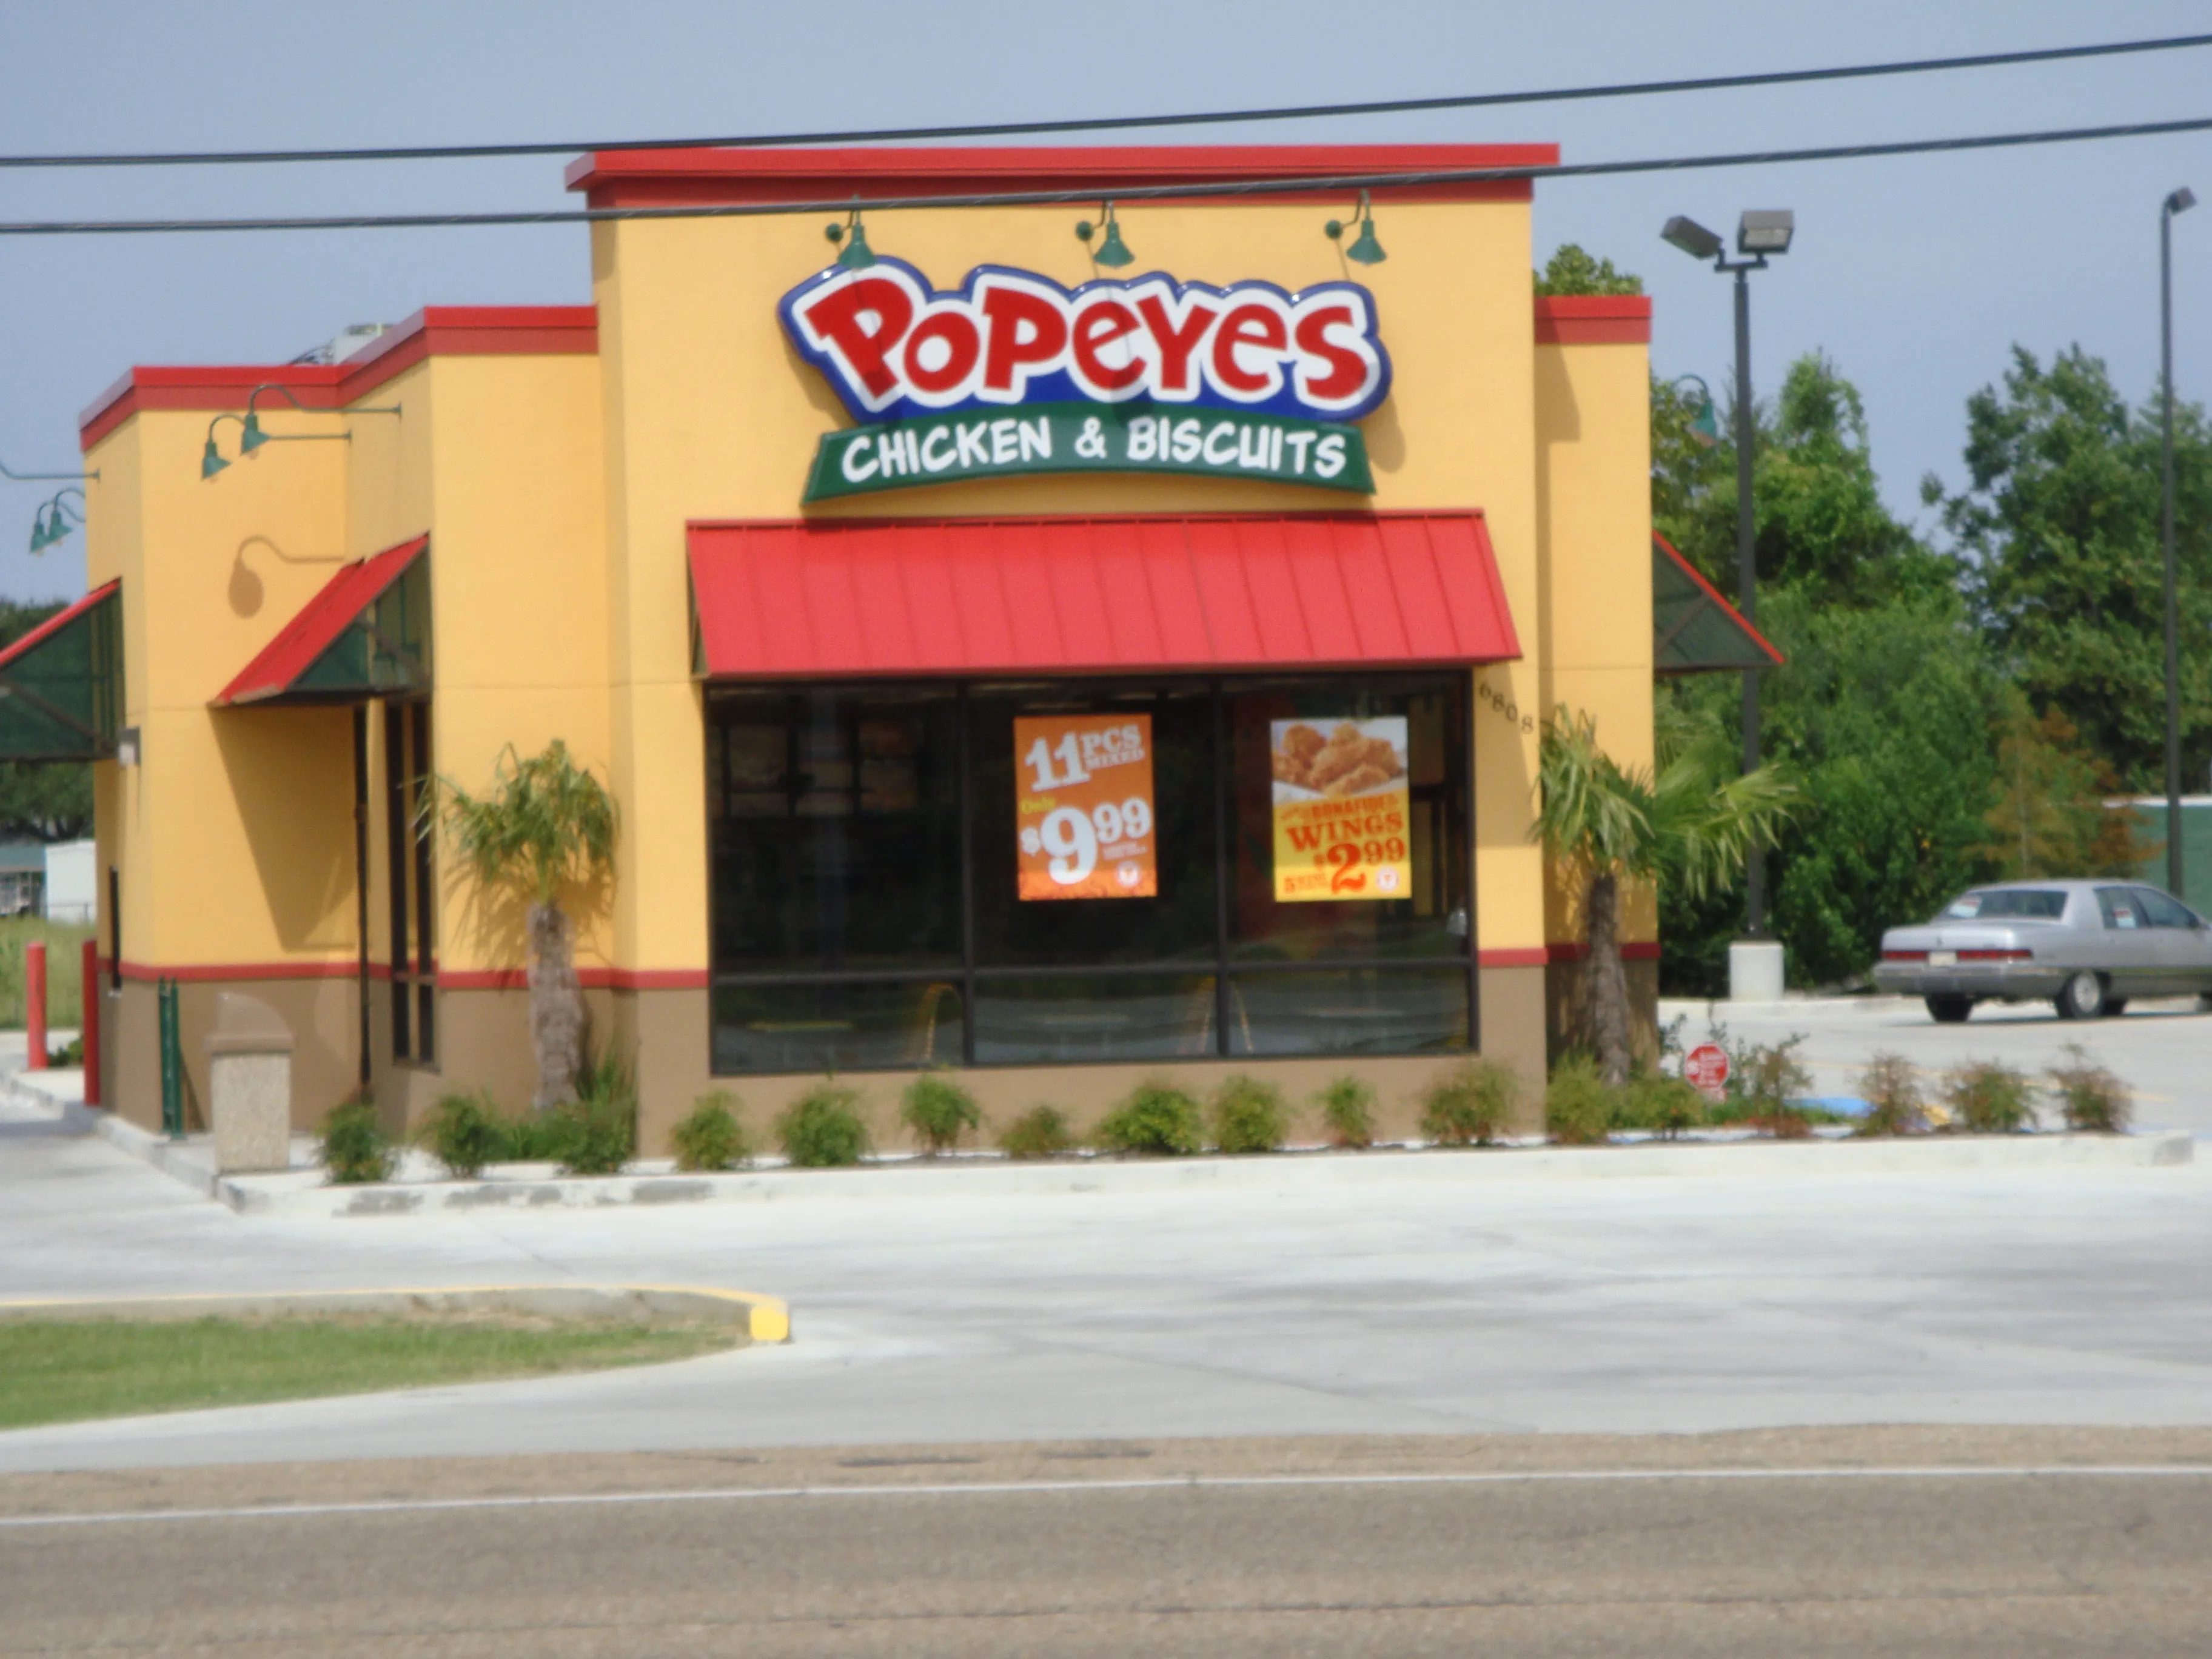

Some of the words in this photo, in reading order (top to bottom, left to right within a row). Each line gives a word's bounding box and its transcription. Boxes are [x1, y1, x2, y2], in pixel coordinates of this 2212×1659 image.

[842, 416, 1051, 483] CHICKEN
[1074, 416, 1107, 460] &
[1127, 416, 1346, 478] BISCUITS
[1480, 682, 1533, 734] 6808
[1024, 732, 1091, 792] 11
[1081, 724, 1141, 757] PCS
[1285, 812, 1404, 853] WINGS
